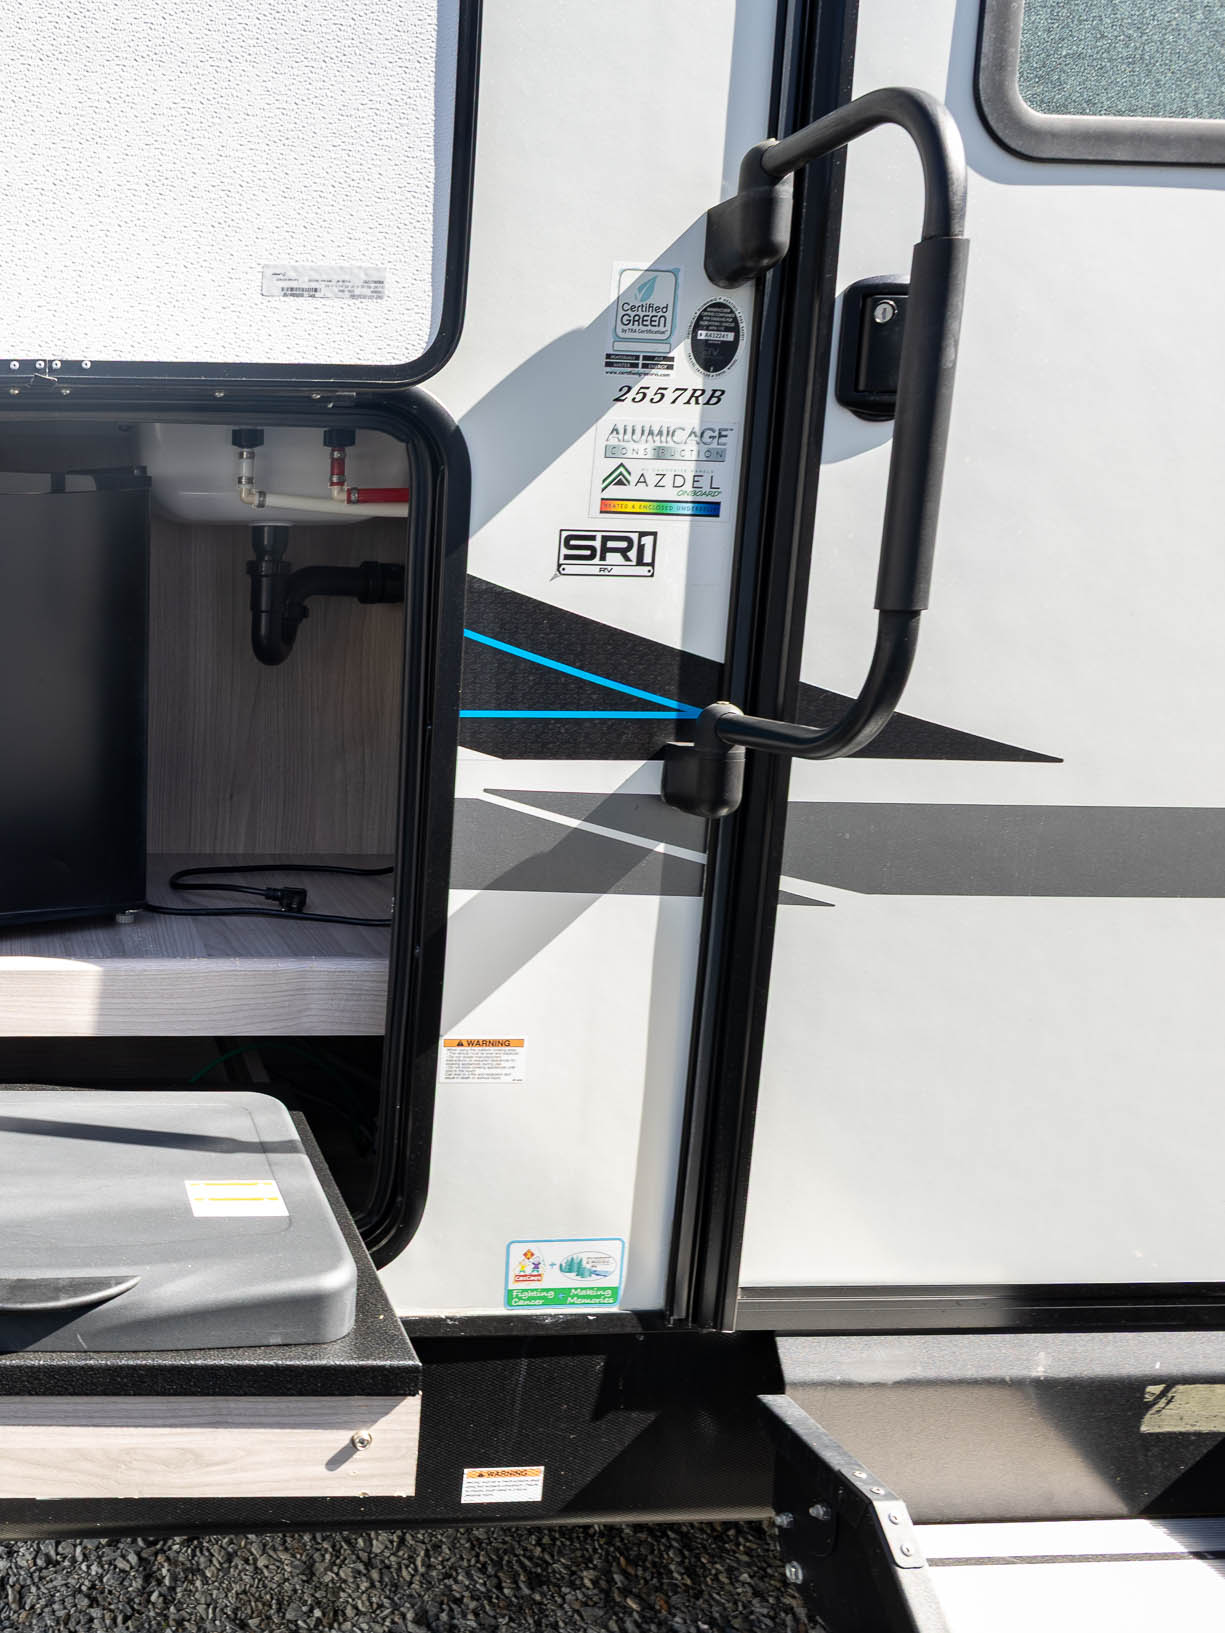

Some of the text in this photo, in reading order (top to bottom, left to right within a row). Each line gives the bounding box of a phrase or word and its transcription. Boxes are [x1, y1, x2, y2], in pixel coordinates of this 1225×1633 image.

[621, 302, 669, 314] Certified
[620, 313, 667, 328] GREEN
[612, 385, 726, 406] 2557RB
[606, 424, 729, 446] ALUMICAGE
[610, 446, 724, 459] CONSTRUCTION
[634, 472, 721, 490] AZDEL
[676, 489, 720, 498] ONBOARD
[638, 504, 673, 512] ENCLOSED
[563, 534, 655, 563] SR1
[467, 1039, 511, 1047] WARNING
[511, 1287, 612, 1299] Fighting Making
[511, 1296, 614, 1306] Cancer Memories
[487, 1469, 528, 1478] WARNING
